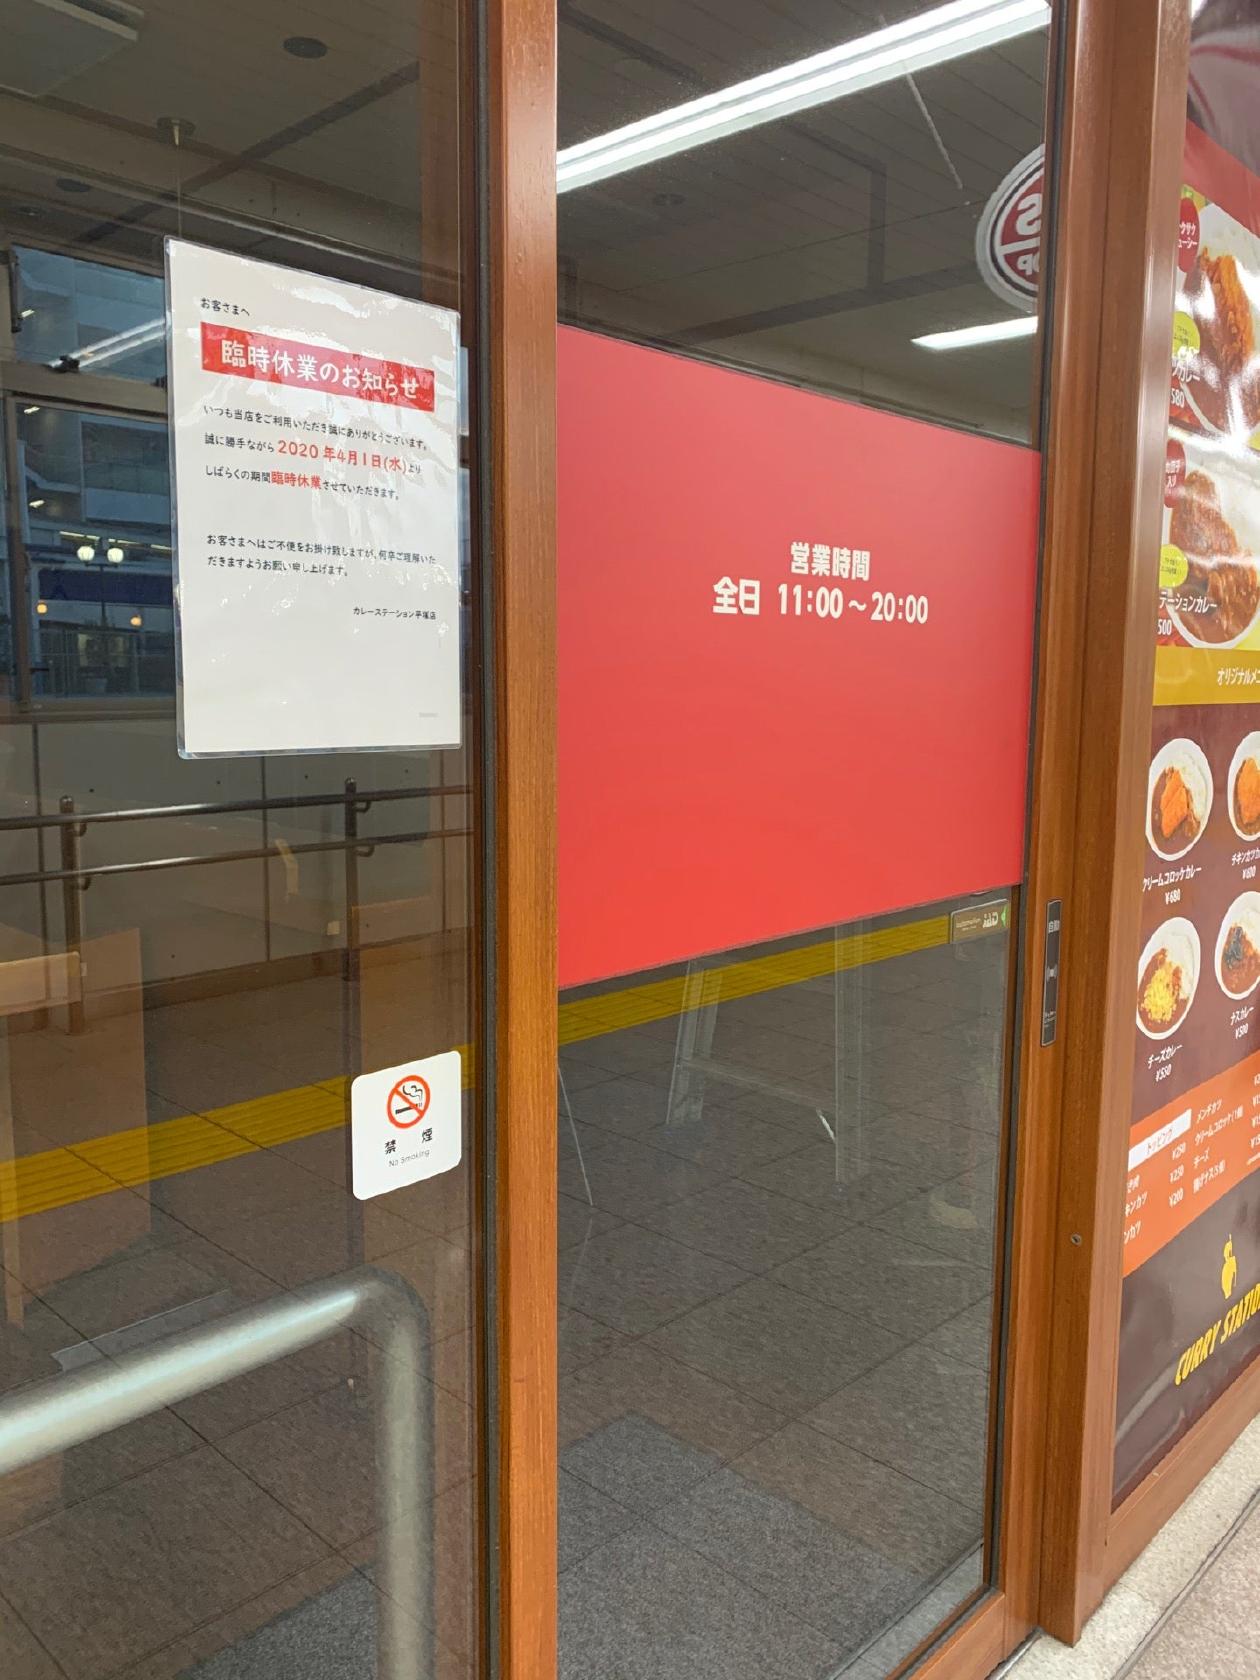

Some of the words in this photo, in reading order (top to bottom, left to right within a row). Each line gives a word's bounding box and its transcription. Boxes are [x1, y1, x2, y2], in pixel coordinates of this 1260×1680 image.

[200, 298, 250, 317] お客さまへ
[220, 339, 419, 399] 臨時休業のお知らせ
[203, 405, 428, 451] いつも当店をご利用いただき誠にありがとうございます。
[207, 555, 348, 576] だきますようお願い申し上げます。
[790, 541, 871, 581] 営業時間
[712, 576, 761, 616] 全日
[1174, 1319, 1222, 1386] CURRY
